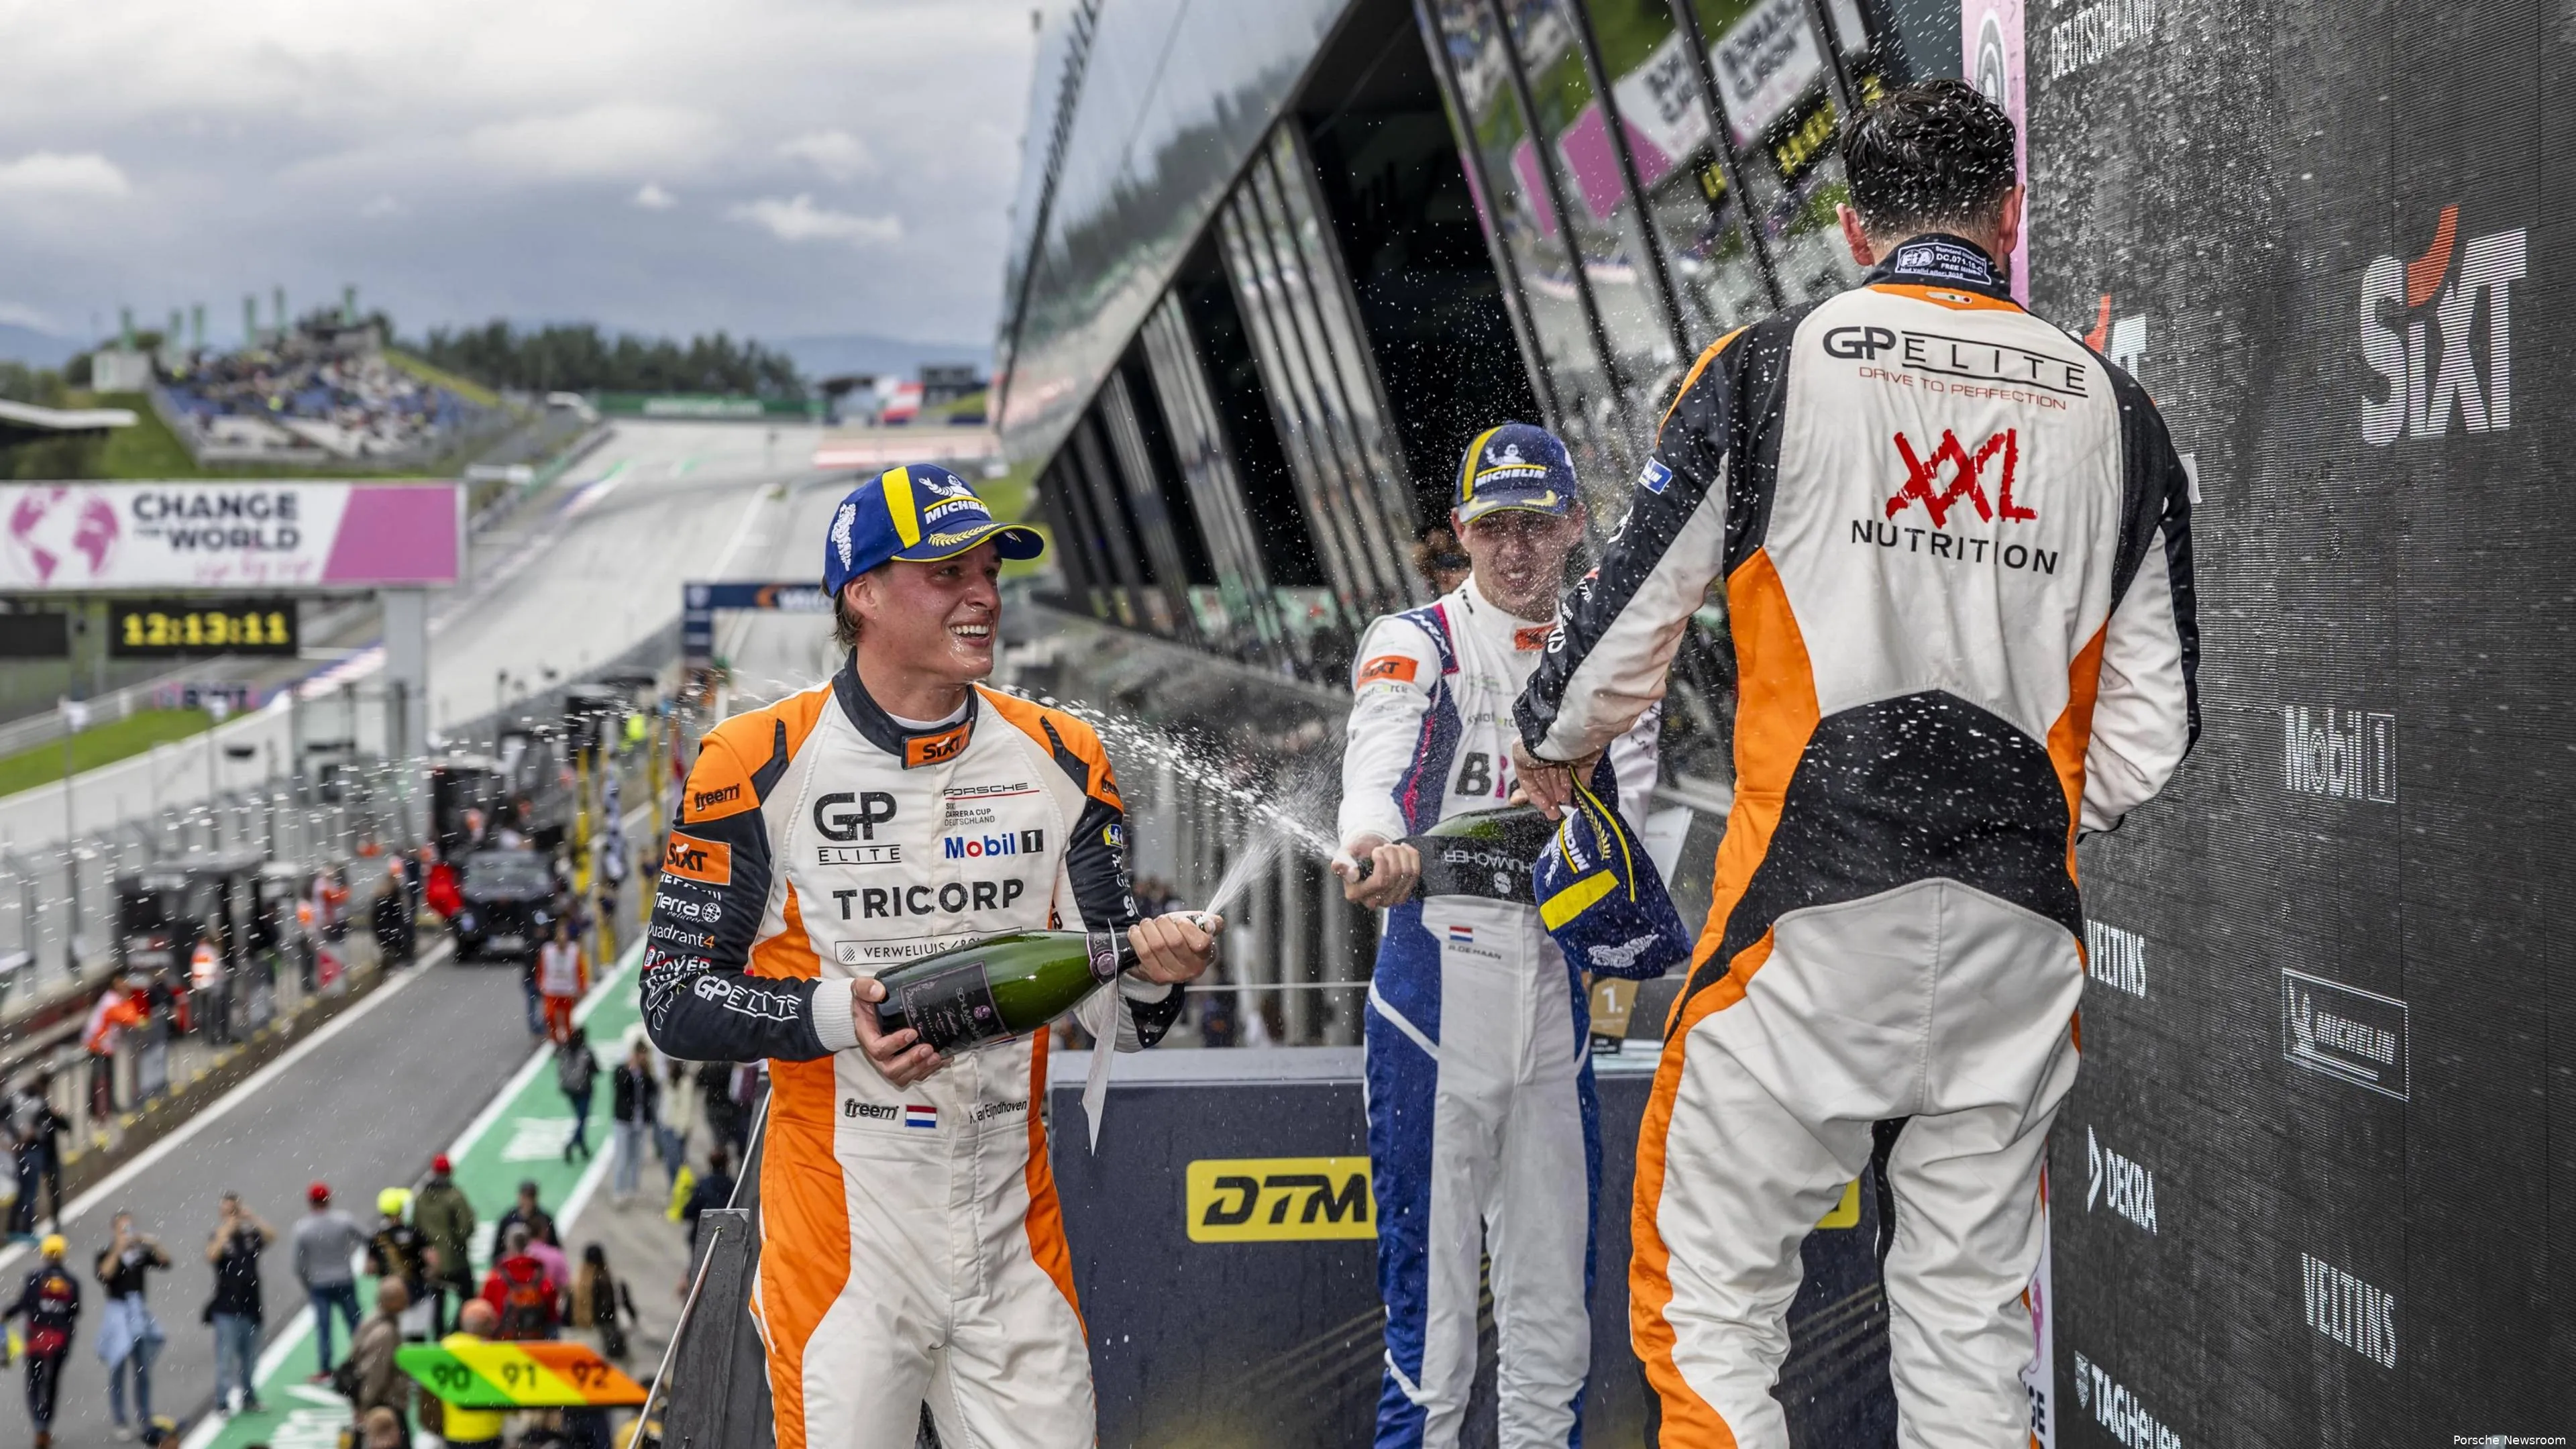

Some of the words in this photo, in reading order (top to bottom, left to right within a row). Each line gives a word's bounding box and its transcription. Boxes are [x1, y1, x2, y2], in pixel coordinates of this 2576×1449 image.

[1901, 251, 1931, 267] FIA
[2361, 205, 2526, 446] SIXT
[1823, 326, 1896, 360] GP
[1903, 337, 2087, 391] ELITE
[1860, 366, 1913, 386] DRIVE
[1921, 377, 1944, 392] TO
[1951, 384, 2066, 410] PERFECTION
[1475, 468, 1546, 488] MICHELIN
[1886, 428, 2039, 529] XXL
[133, 492, 299, 521] CHANGE
[168, 528, 301, 551] WORLD
[1851, 520, 2058, 575] NUTRITION
[122, 611, 290, 646] 12:13:11
[923, 736, 963, 760] SIXT
[2286, 706, 2362, 799] Mobil
[694, 784, 741, 811] freem
[943, 782, 1029, 796] PORSCHE
[814, 792, 897, 841] GP
[945, 809, 975, 818] CARRERA
[945, 816, 996, 826] DEUTSCHLAND
[666, 843, 708, 872] SIXT
[819, 847, 901, 862] ELITE
[945, 833, 1016, 859] Mobil
[1564, 809, 1591, 872] MICHE
[1444, 849, 1536, 875] HUMACHER
[833, 879, 1024, 920] TRICORP
[2086, 918, 2146, 999] VELTINS
[694, 975, 732, 1002] GP
[727, 987, 803, 1016] ELITE
[2316, 1012, 2396, 1065] MICHELIN
[844, 1098, 899, 1120] freem
[1202, 1173, 1367, 1226] DTM
[2106, 1148, 2157, 1236] DEKRA
[2302, 1252, 2397, 1369] VELTINS
[431, 1364, 470, 1391] 90
[502, 1362, 537, 1389] 91
[571, 1362, 608, 1389] 92
